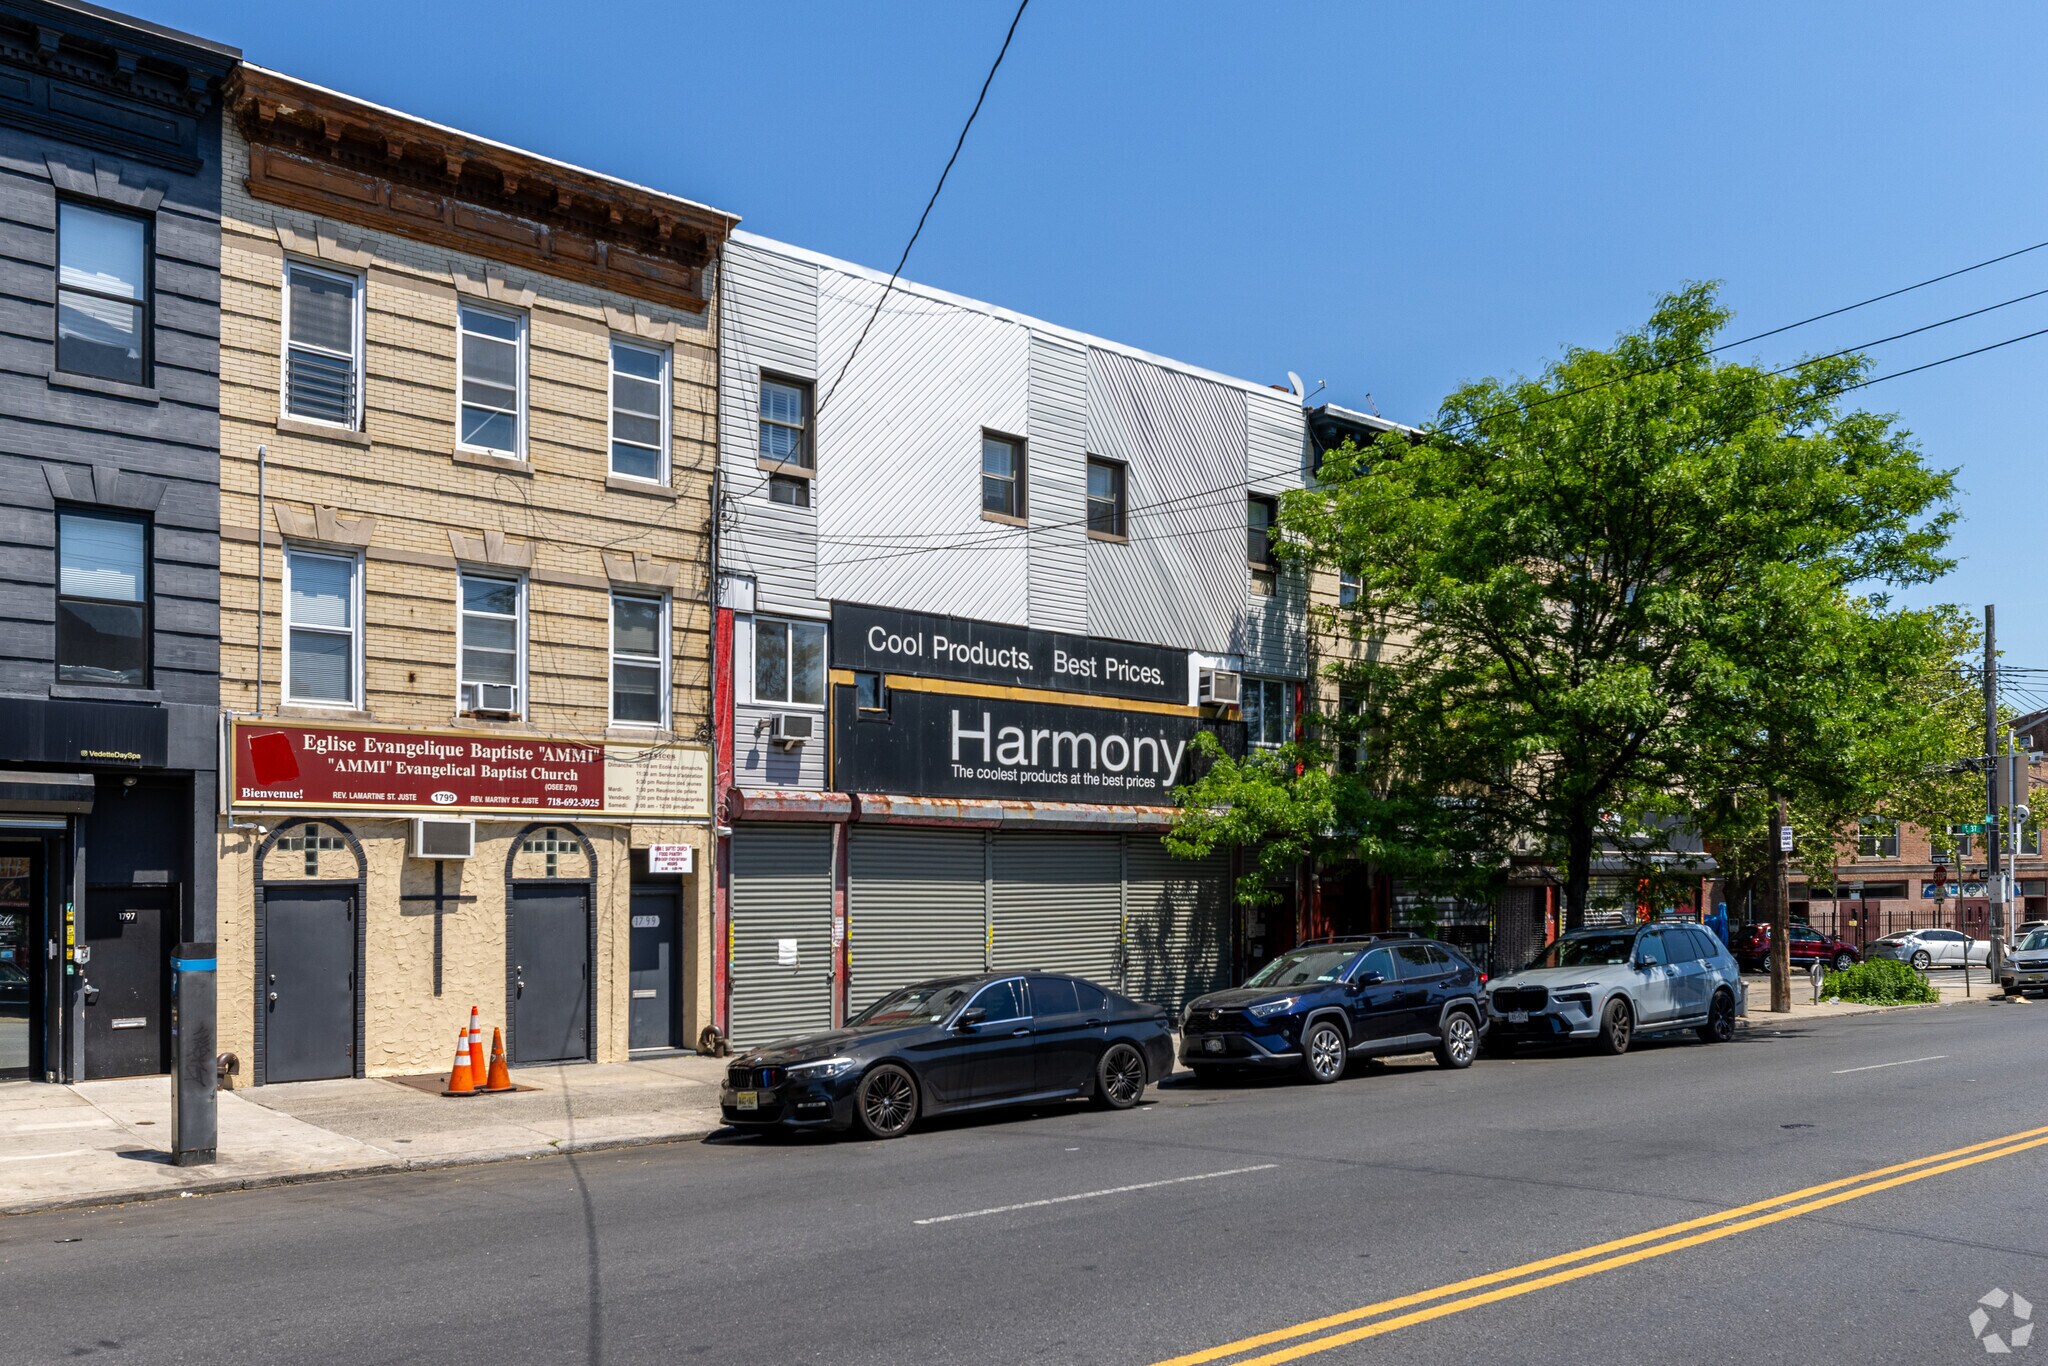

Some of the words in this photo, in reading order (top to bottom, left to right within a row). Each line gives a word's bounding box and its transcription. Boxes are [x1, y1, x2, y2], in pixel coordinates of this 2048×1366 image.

[867, 625, 923, 657] Cool
[933, 634, 1034, 671] Products.
[1054, 650, 1097, 678] Best
[1105, 657, 1165, 686] Prices.
[302, 733, 356, 755] Eglise
[363, 737, 464, 760] Evangelique
[470, 743, 533, 763] Baptiste
[539, 746, 600, 763] "AMMI"
[951, 709, 1186, 787] Harmony
[89, 750, 141, 760] VedetteDaySpa
[328, 757, 392, 774] "AMMI"
[396, 761, 476, 779] Evangelical
[481, 765, 527, 781] Baptist
[531, 766, 578, 781] Church
[952, 764, 974, 779] The
[976, 766, 1018, 782] coolest
[1020, 769, 1067, 785] products
[1070, 772, 1081, 785] at
[1083, 772, 1100, 786] the
[1101, 773, 1124, 788] best
[1126, 775, 1156, 790] prices
[241, 787, 304, 800] Bienvenue!
[544, 784, 564, 792] (OSEE
[564, 784, 578, 793] 2V3)
[332, 791, 347, 800] REV.
[349, 792, 385, 800] LAMARTINE
[386, 793, 396, 801] ST.
[397, 793, 417, 801] JUSTE
[434, 793, 454, 802] 1799
[470, 795, 483, 803] REV.
[485, 796, 510, 804] MARTINY
[511, 796, 520, 804] ST.
[521, 797, 539, 805] JUSTE
[547, 797, 600, 808] 718-692-3925
[1934, 871, 1946, 880] STOP
[118, 912, 136, 921] 1797
[635, 916, 656, 926] 1799
